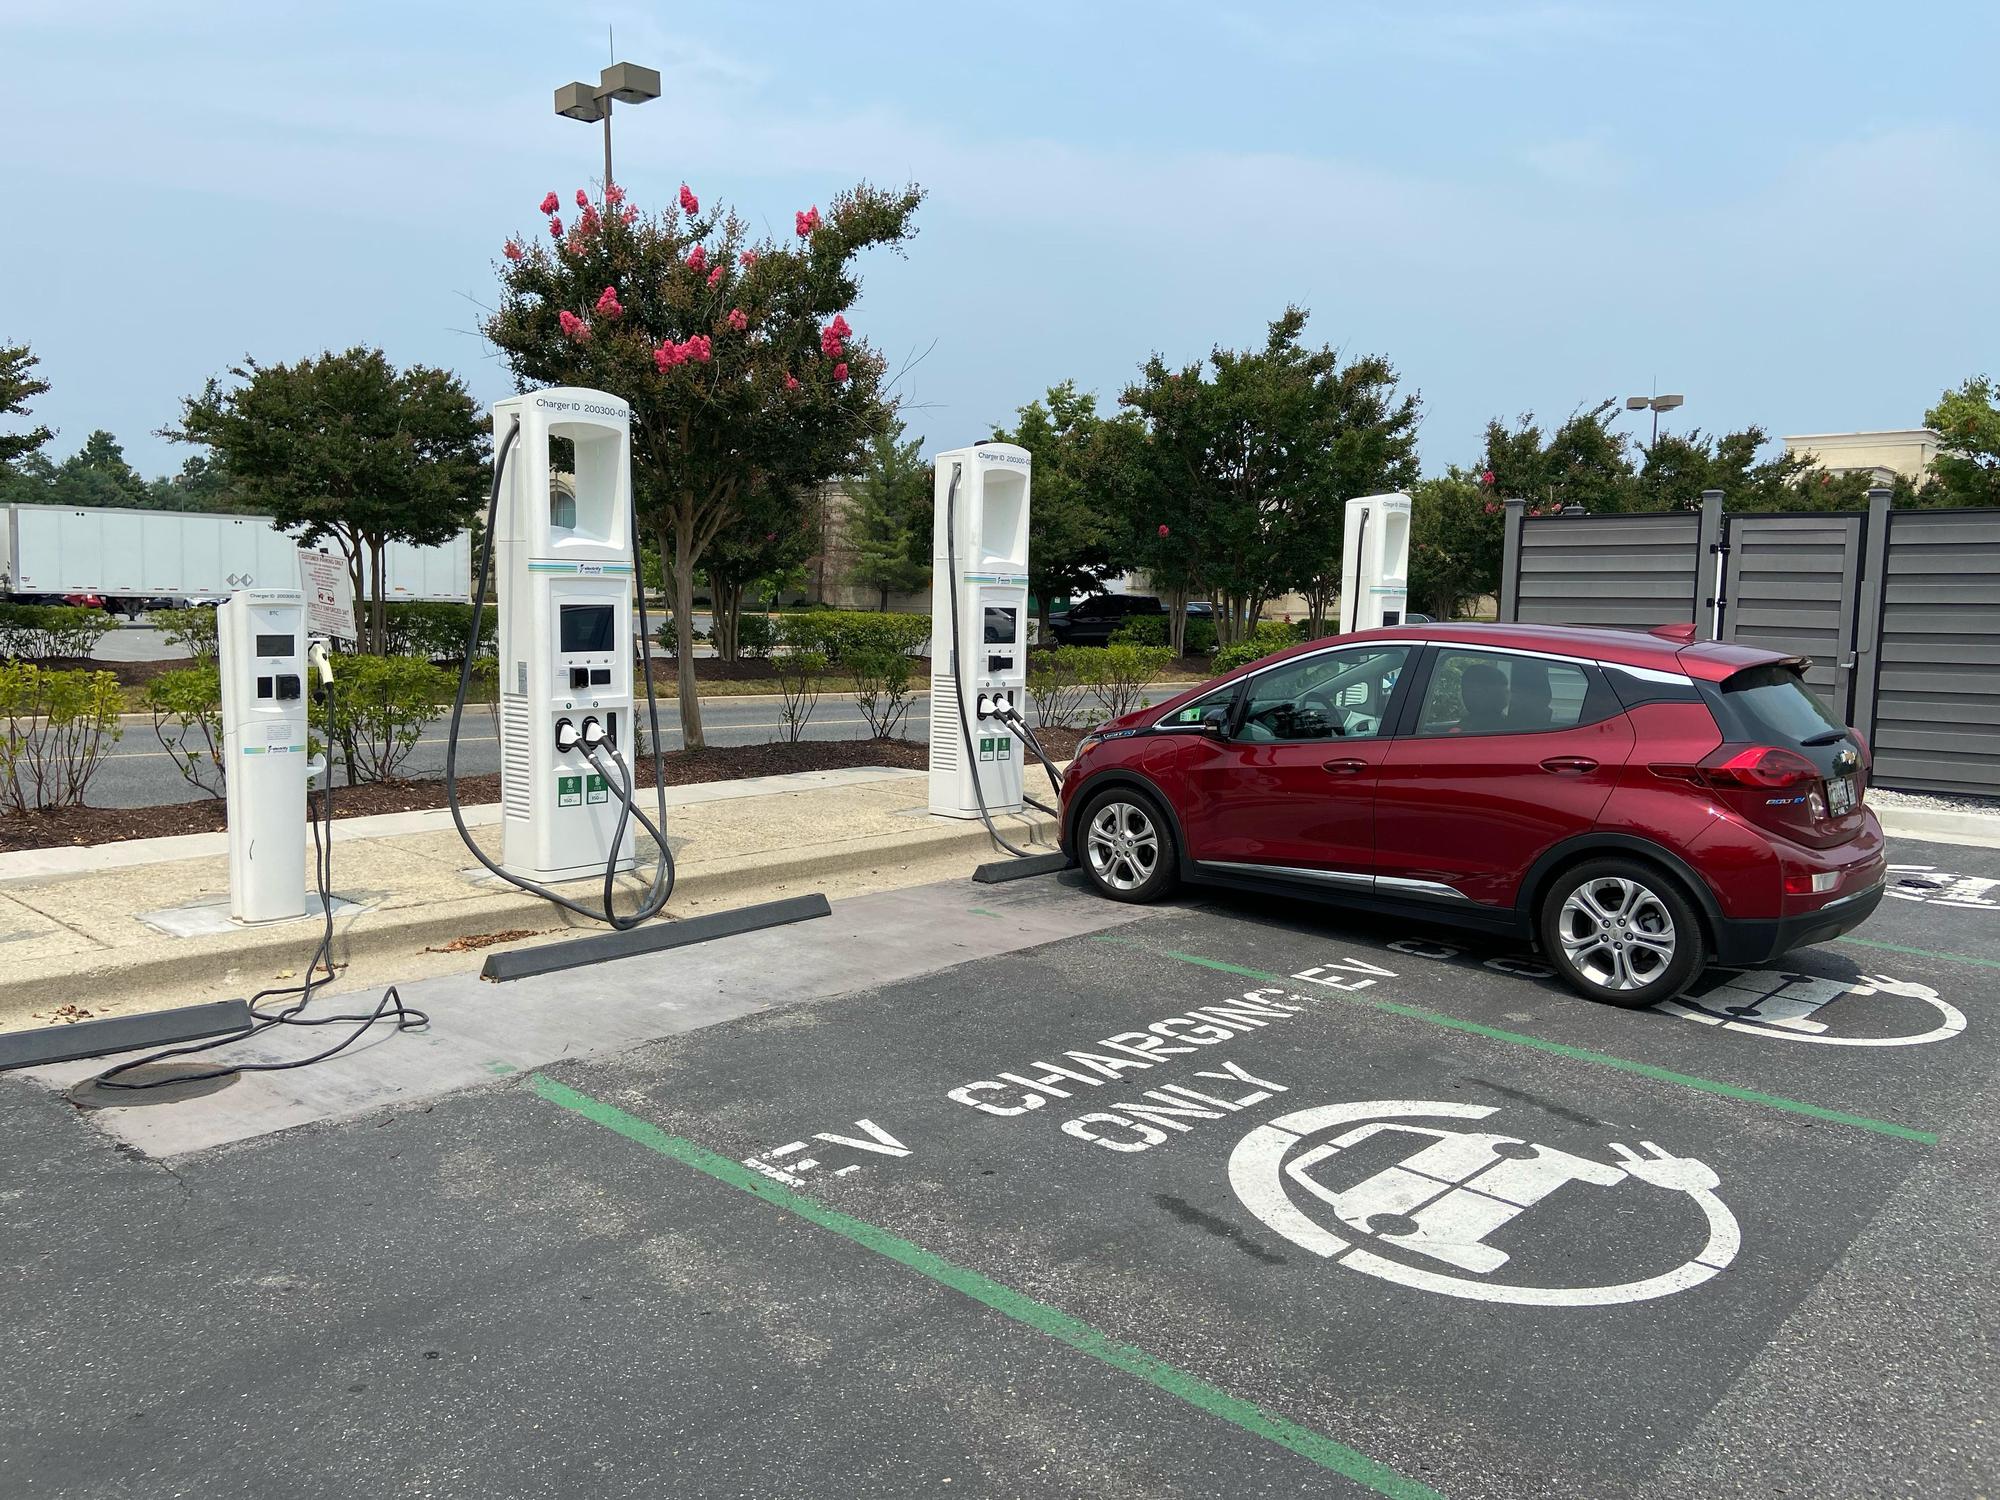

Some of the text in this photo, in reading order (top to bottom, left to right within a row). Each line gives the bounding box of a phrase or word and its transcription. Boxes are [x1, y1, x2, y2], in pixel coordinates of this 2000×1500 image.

[536, 399, 627, 418] Charger ID 200300-01
[978, 452, 998, 461] Charger
[1290, 957, 1400, 992] EV
[741, 988, 1310, 1188] EV CHARGING
[1061, 1061, 1289, 1152] ONLY
